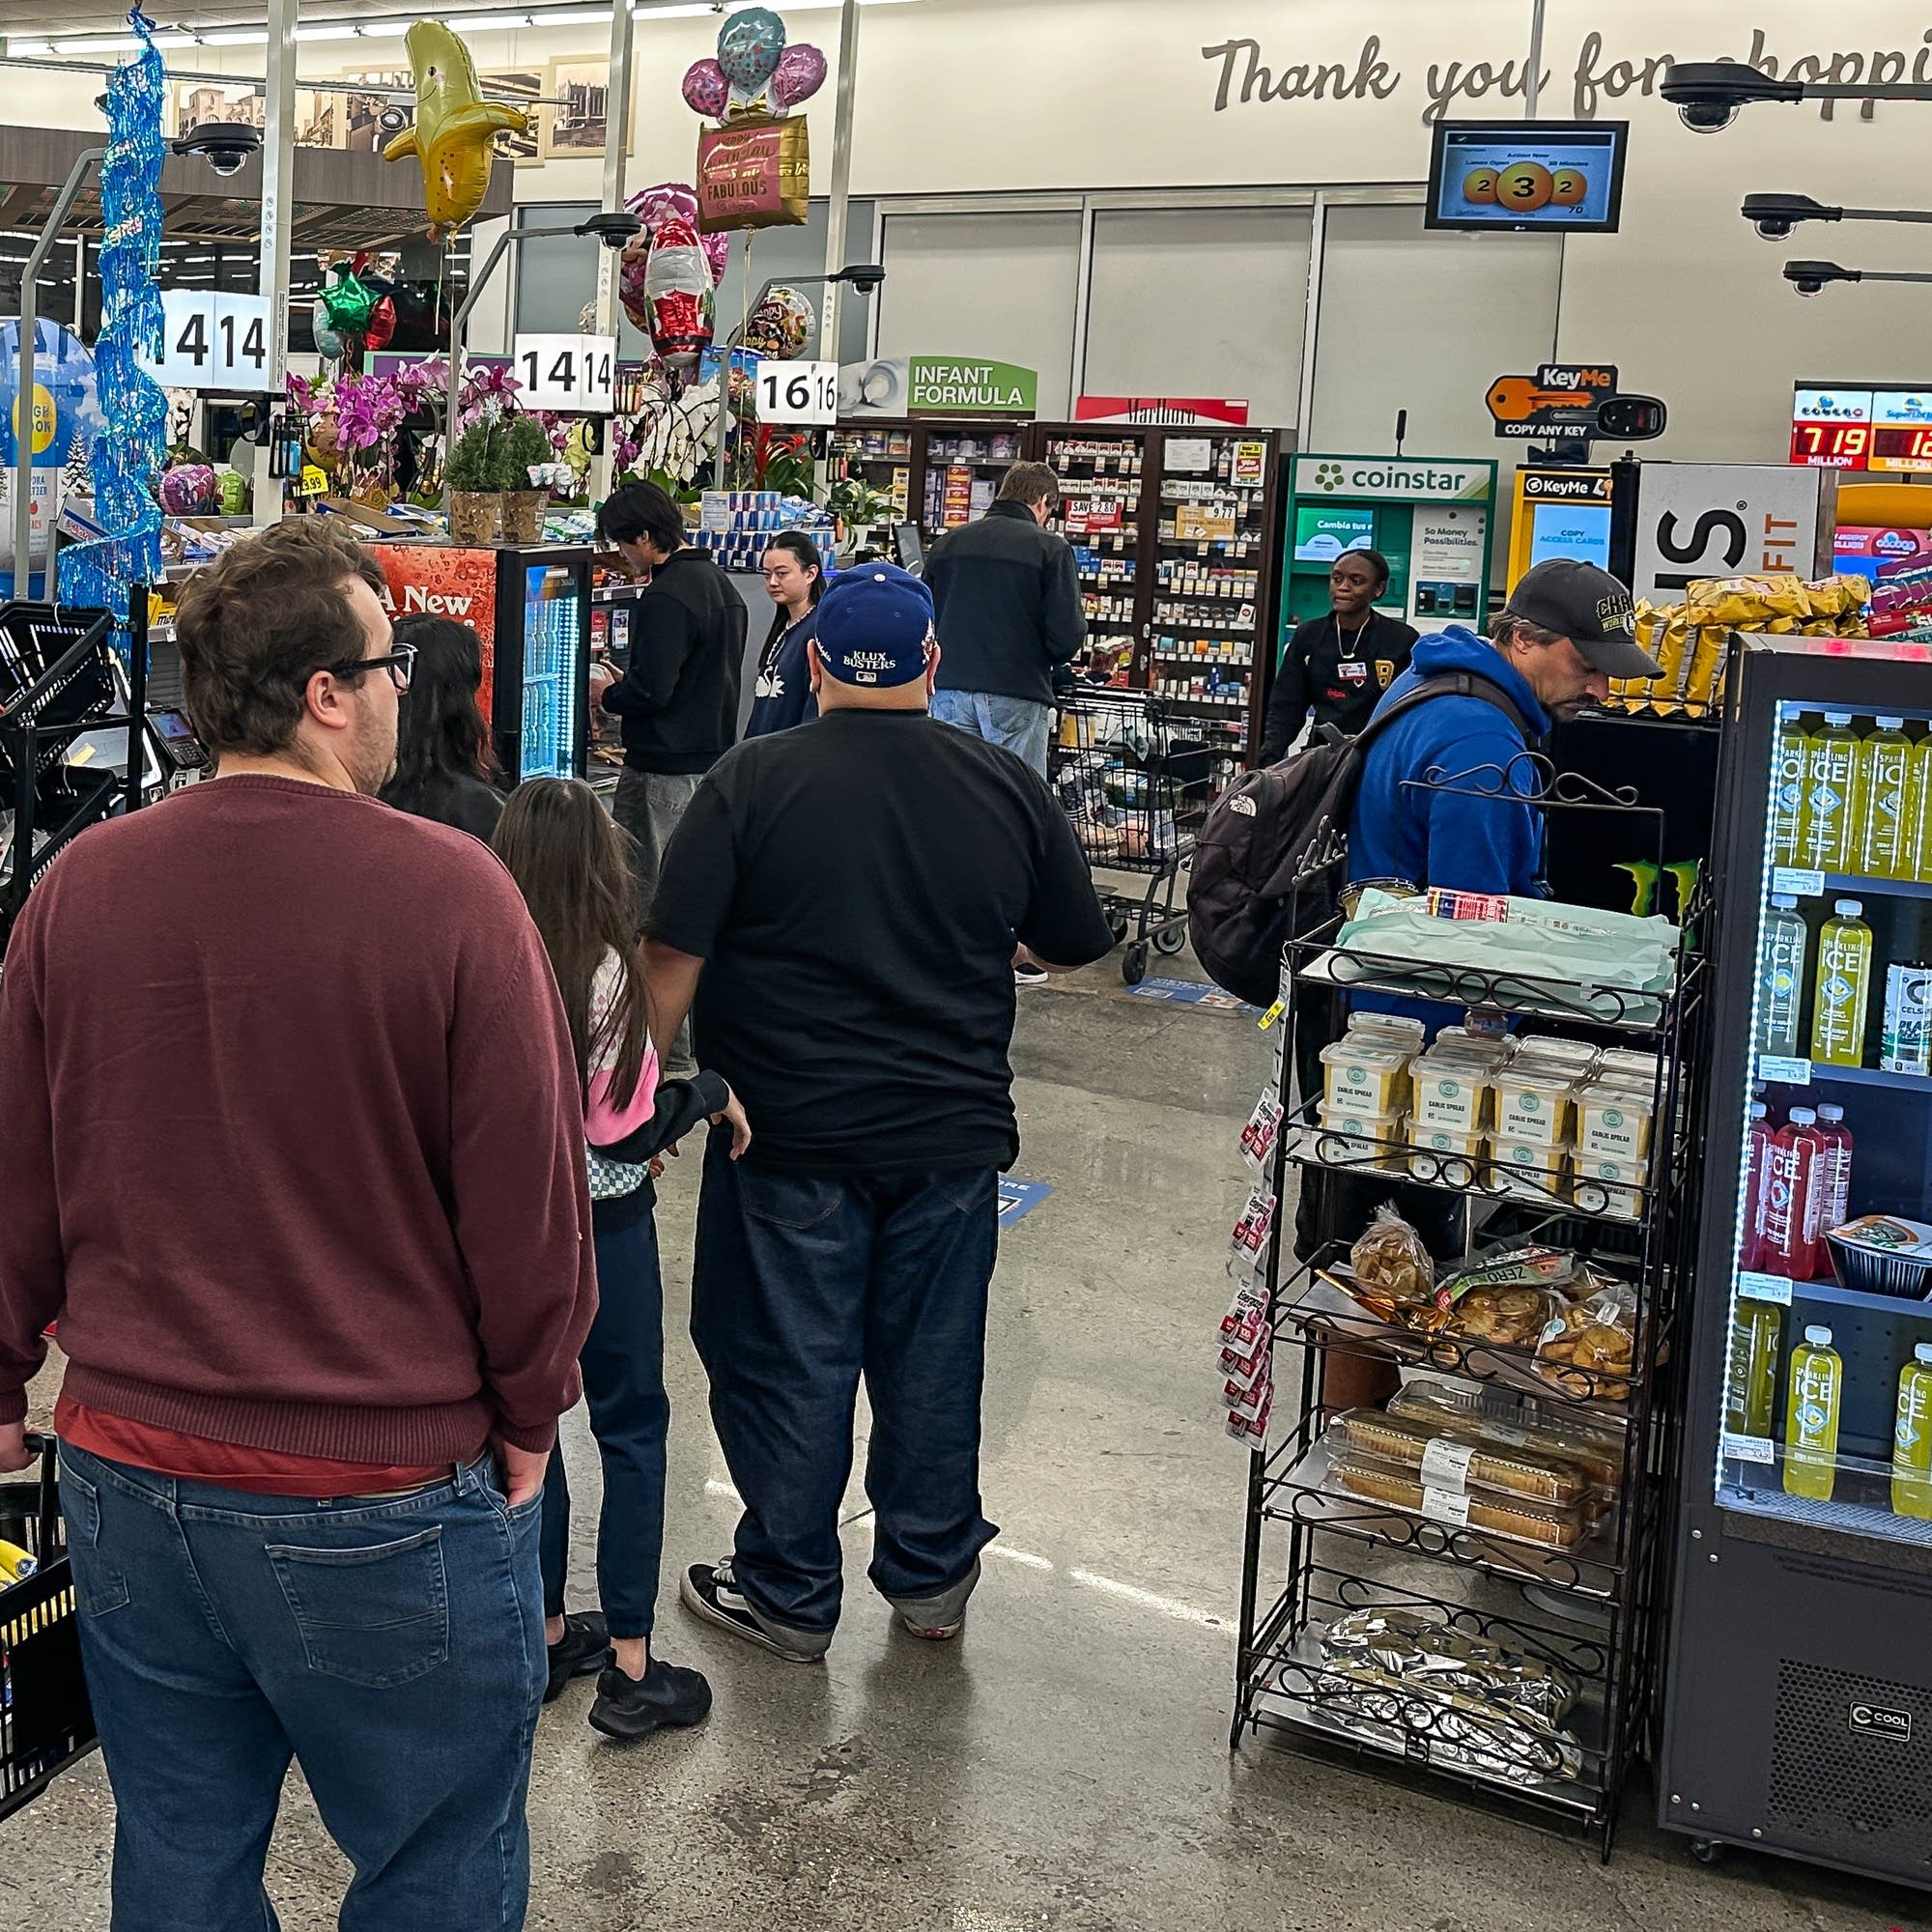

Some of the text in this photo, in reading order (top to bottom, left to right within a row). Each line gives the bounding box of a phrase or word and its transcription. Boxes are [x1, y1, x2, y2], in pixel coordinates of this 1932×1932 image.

[1202, 35, 1401, 111] Thank
[1422, 59, 1549, 126] you
[707, 181, 767, 200] FABULOUS
[1477, 180, 1491, 192] 2
[1513, 177, 1536, 198] 3
[1559, 181, 1574, 193] 2
[220, 315, 266, 369] 14
[522, 351, 577, 392] 14
[584, 352, 611, 394] 14
[914, 365, 994, 384] INFANT
[1543, 368, 1611, 389] KeyMe
[763, 375, 810, 410] 16
[817, 376, 836, 411] 16
[913, 385, 1024, 406] FORMULA
[1504, 424, 1587, 437] COPY ANY KEY
[1804, 427, 1867, 456] 719
[1807, 455, 1853, 467] MILLION
[1352, 466, 1466, 491] coinstar
[1543, 480, 1589, 496] KeyMe
[1072, 502, 1094, 513] SAVE
[1317, 520, 1366, 530] Cambia tus
[1436, 528, 1468, 538] Money
[1762, 513, 1798, 572] FIT
[402, 584, 473, 615] New
[843, 655, 896, 670] BUSTERS
[853, 650, 887, 661] KLUX
[1808, 758, 1848, 783] ICE
[1765, 942, 1802, 964] ICE
[1822, 948, 1860, 973] ICE
[1794, 1374, 1833, 1402] ICE
[1873, 1712, 1909, 1727] COOL
